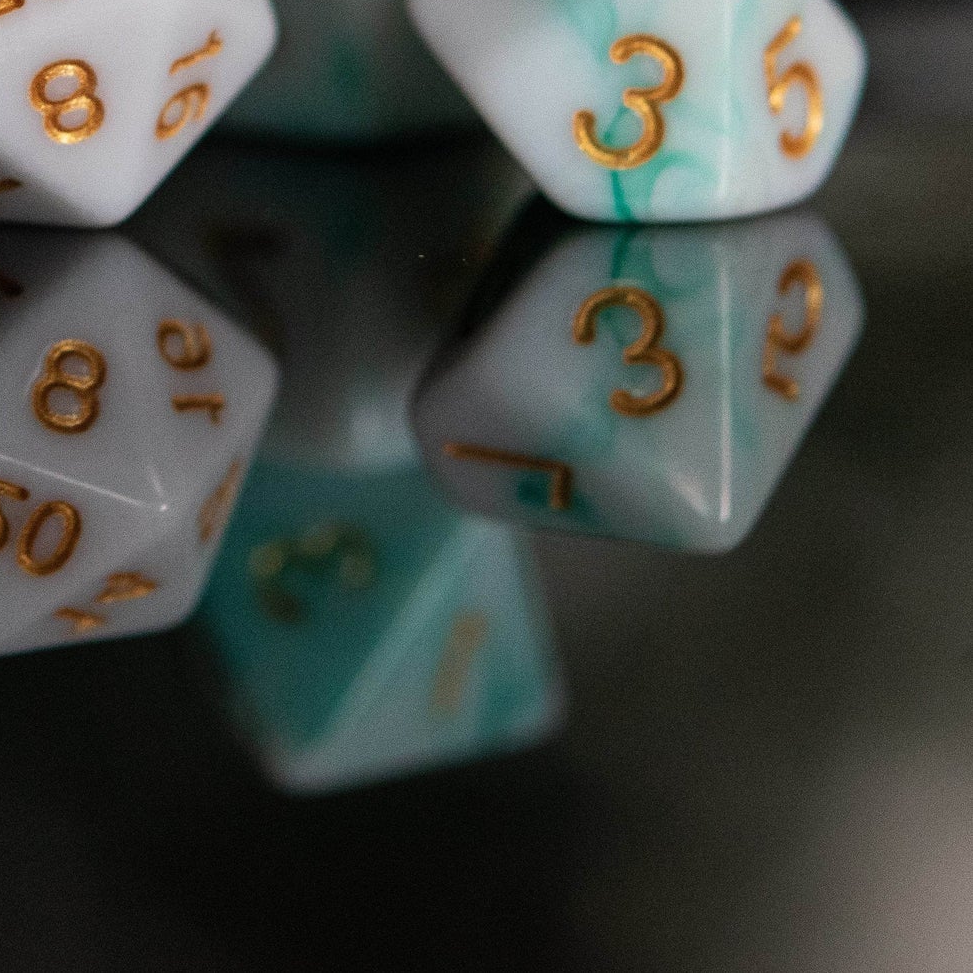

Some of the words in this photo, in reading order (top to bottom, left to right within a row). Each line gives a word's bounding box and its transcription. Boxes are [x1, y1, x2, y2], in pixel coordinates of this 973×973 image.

[29, 59, 105, 144] 8
[155, 30, 223, 141] 16
[572, 33, 685, 169] 3
[764, 15, 823, 160] 5
